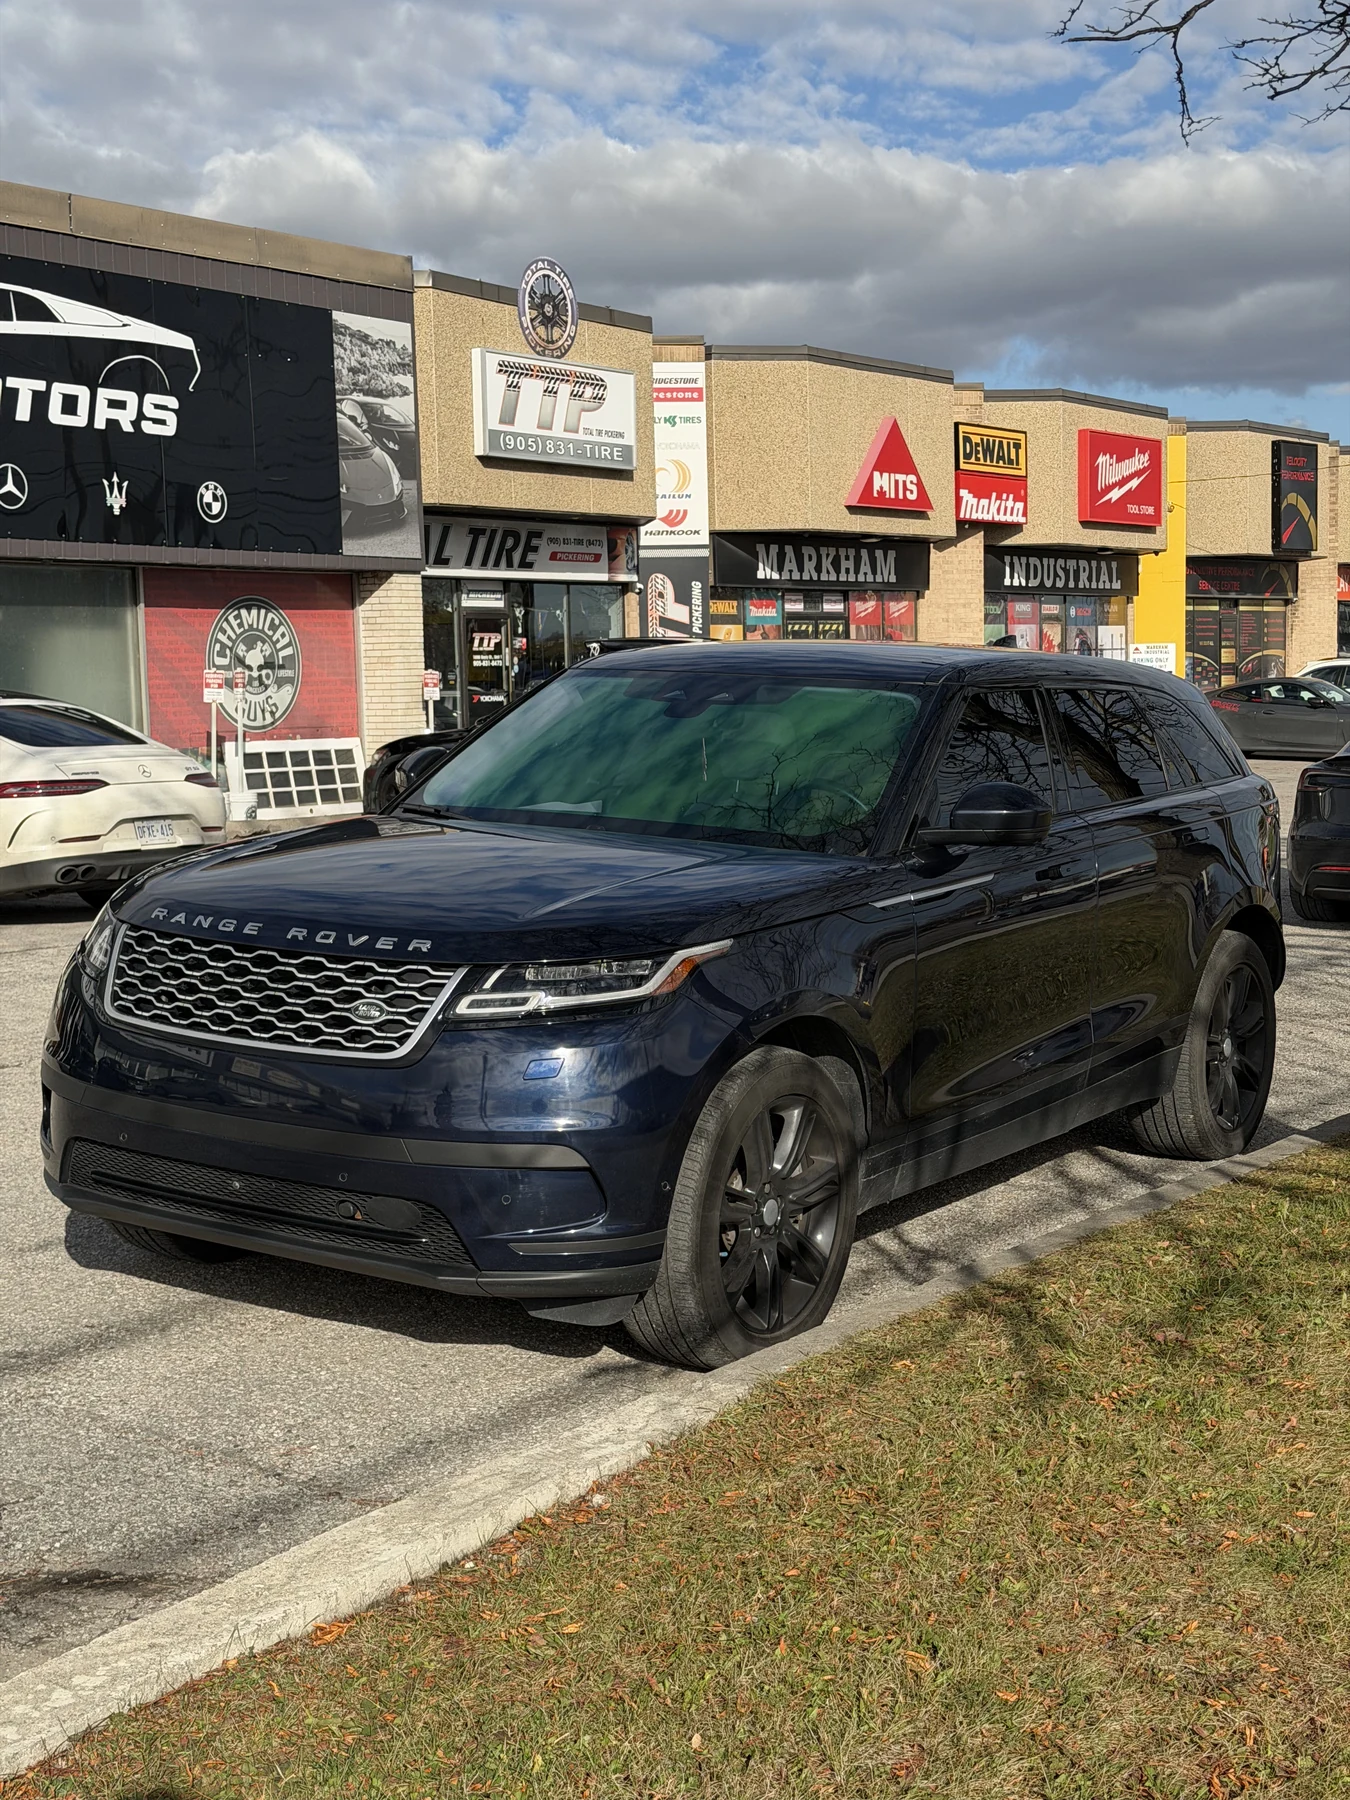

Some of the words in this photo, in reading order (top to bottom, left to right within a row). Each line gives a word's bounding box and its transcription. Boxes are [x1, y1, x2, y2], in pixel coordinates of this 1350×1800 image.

[521, 260, 551, 290] TOTAL
[554, 265, 574, 300] TIRE
[521, 315, 576, 358] PICKERING
[0, 375, 180, 437] TORS
[496, 360, 608, 434] TTP
[653, 391, 699, 399] restone
[678, 416, 702, 424] TIRES
[873, 471, 918, 500] MITS
[1094, 447, 1150, 493] Milwaukee
[1126, 504, 1139, 514] TOOL
[1140, 505, 1155, 515] STORE
[424, 523, 452, 566] L
[463, 526, 544, 569] TIRE
[556, 553, 595, 562] PICKERING
[755, 543, 897, 583] MARKHAM
[1003, 555, 1121, 589] INDUSTRIAL
[691, 580, 703, 634] PICKERING
[1015, 604, 1030, 612] KING
[213, 606, 294, 666] CHEMICAL
[160, 823, 175, 837] 415
[151, 907, 264, 936] RANGE
[286, 927, 433, 953] ROVER
